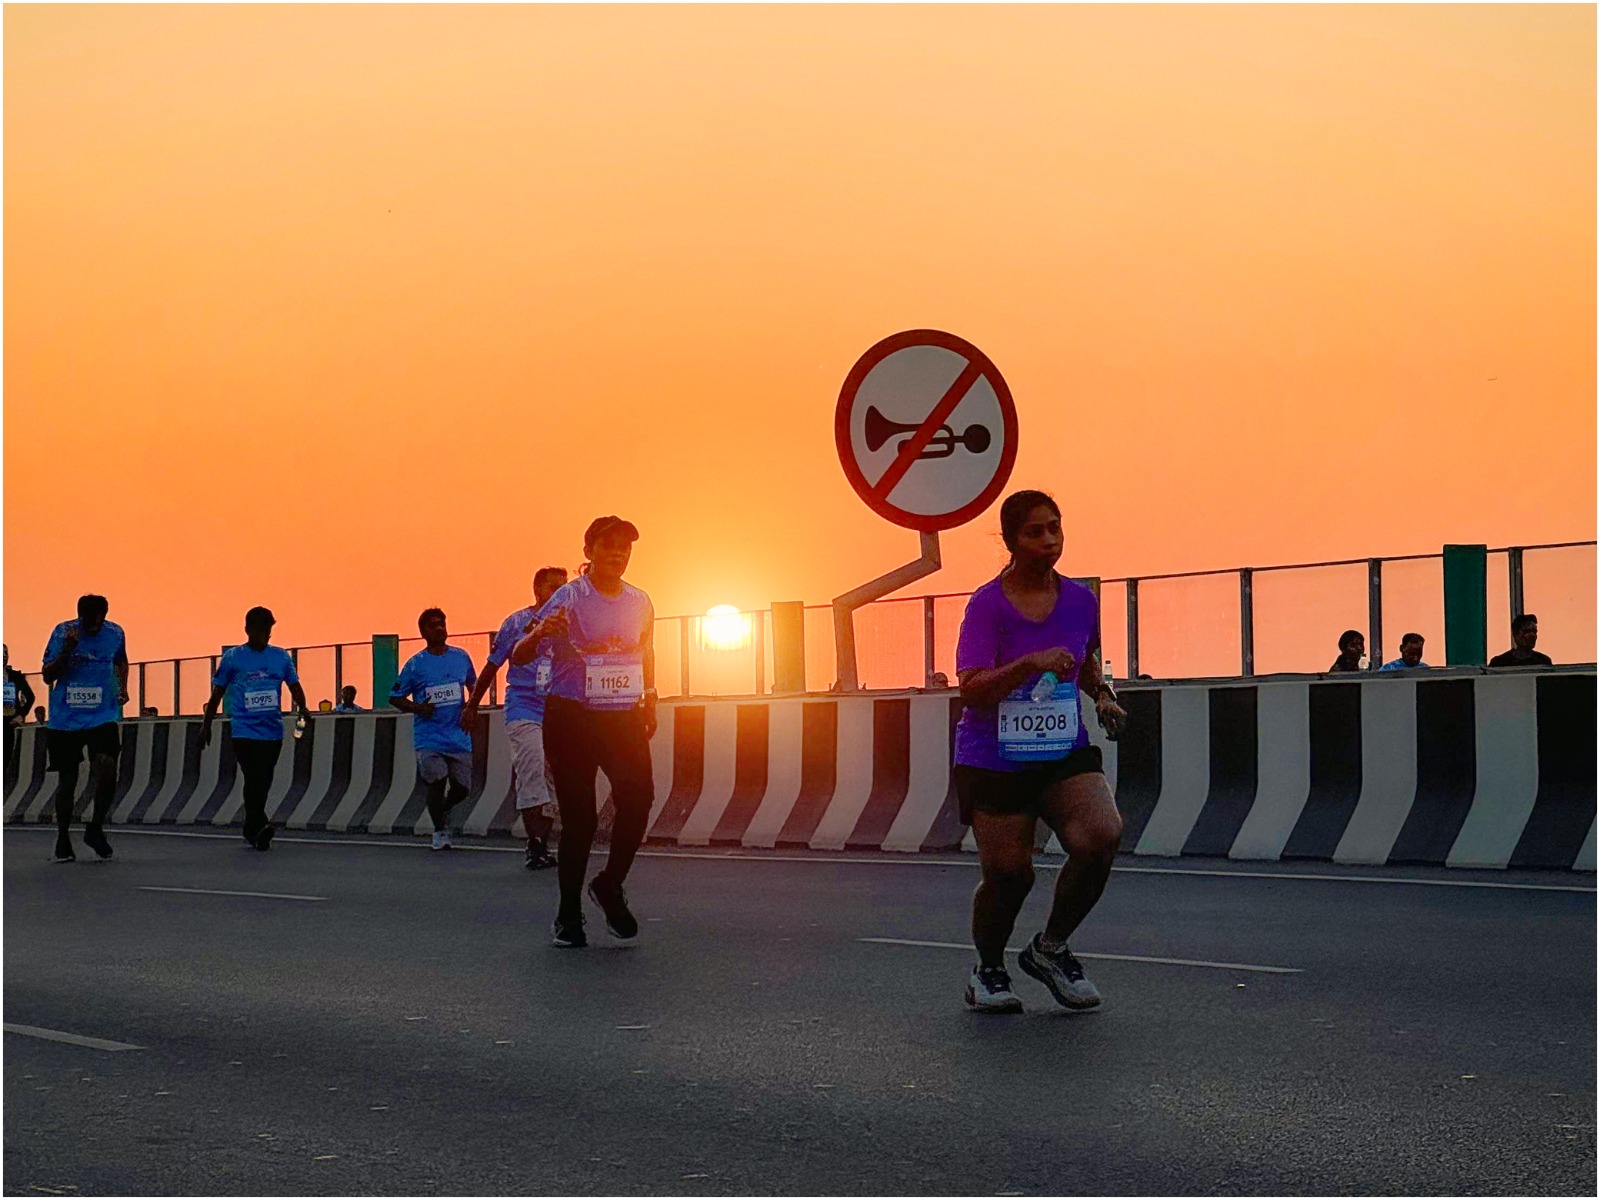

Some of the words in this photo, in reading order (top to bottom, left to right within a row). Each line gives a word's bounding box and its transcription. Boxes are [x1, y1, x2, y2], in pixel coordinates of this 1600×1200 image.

[600, 675, 630, 689] 11162
[250, 695, 273, 704] 10975
[1012, 714, 1067, 732] 10208
